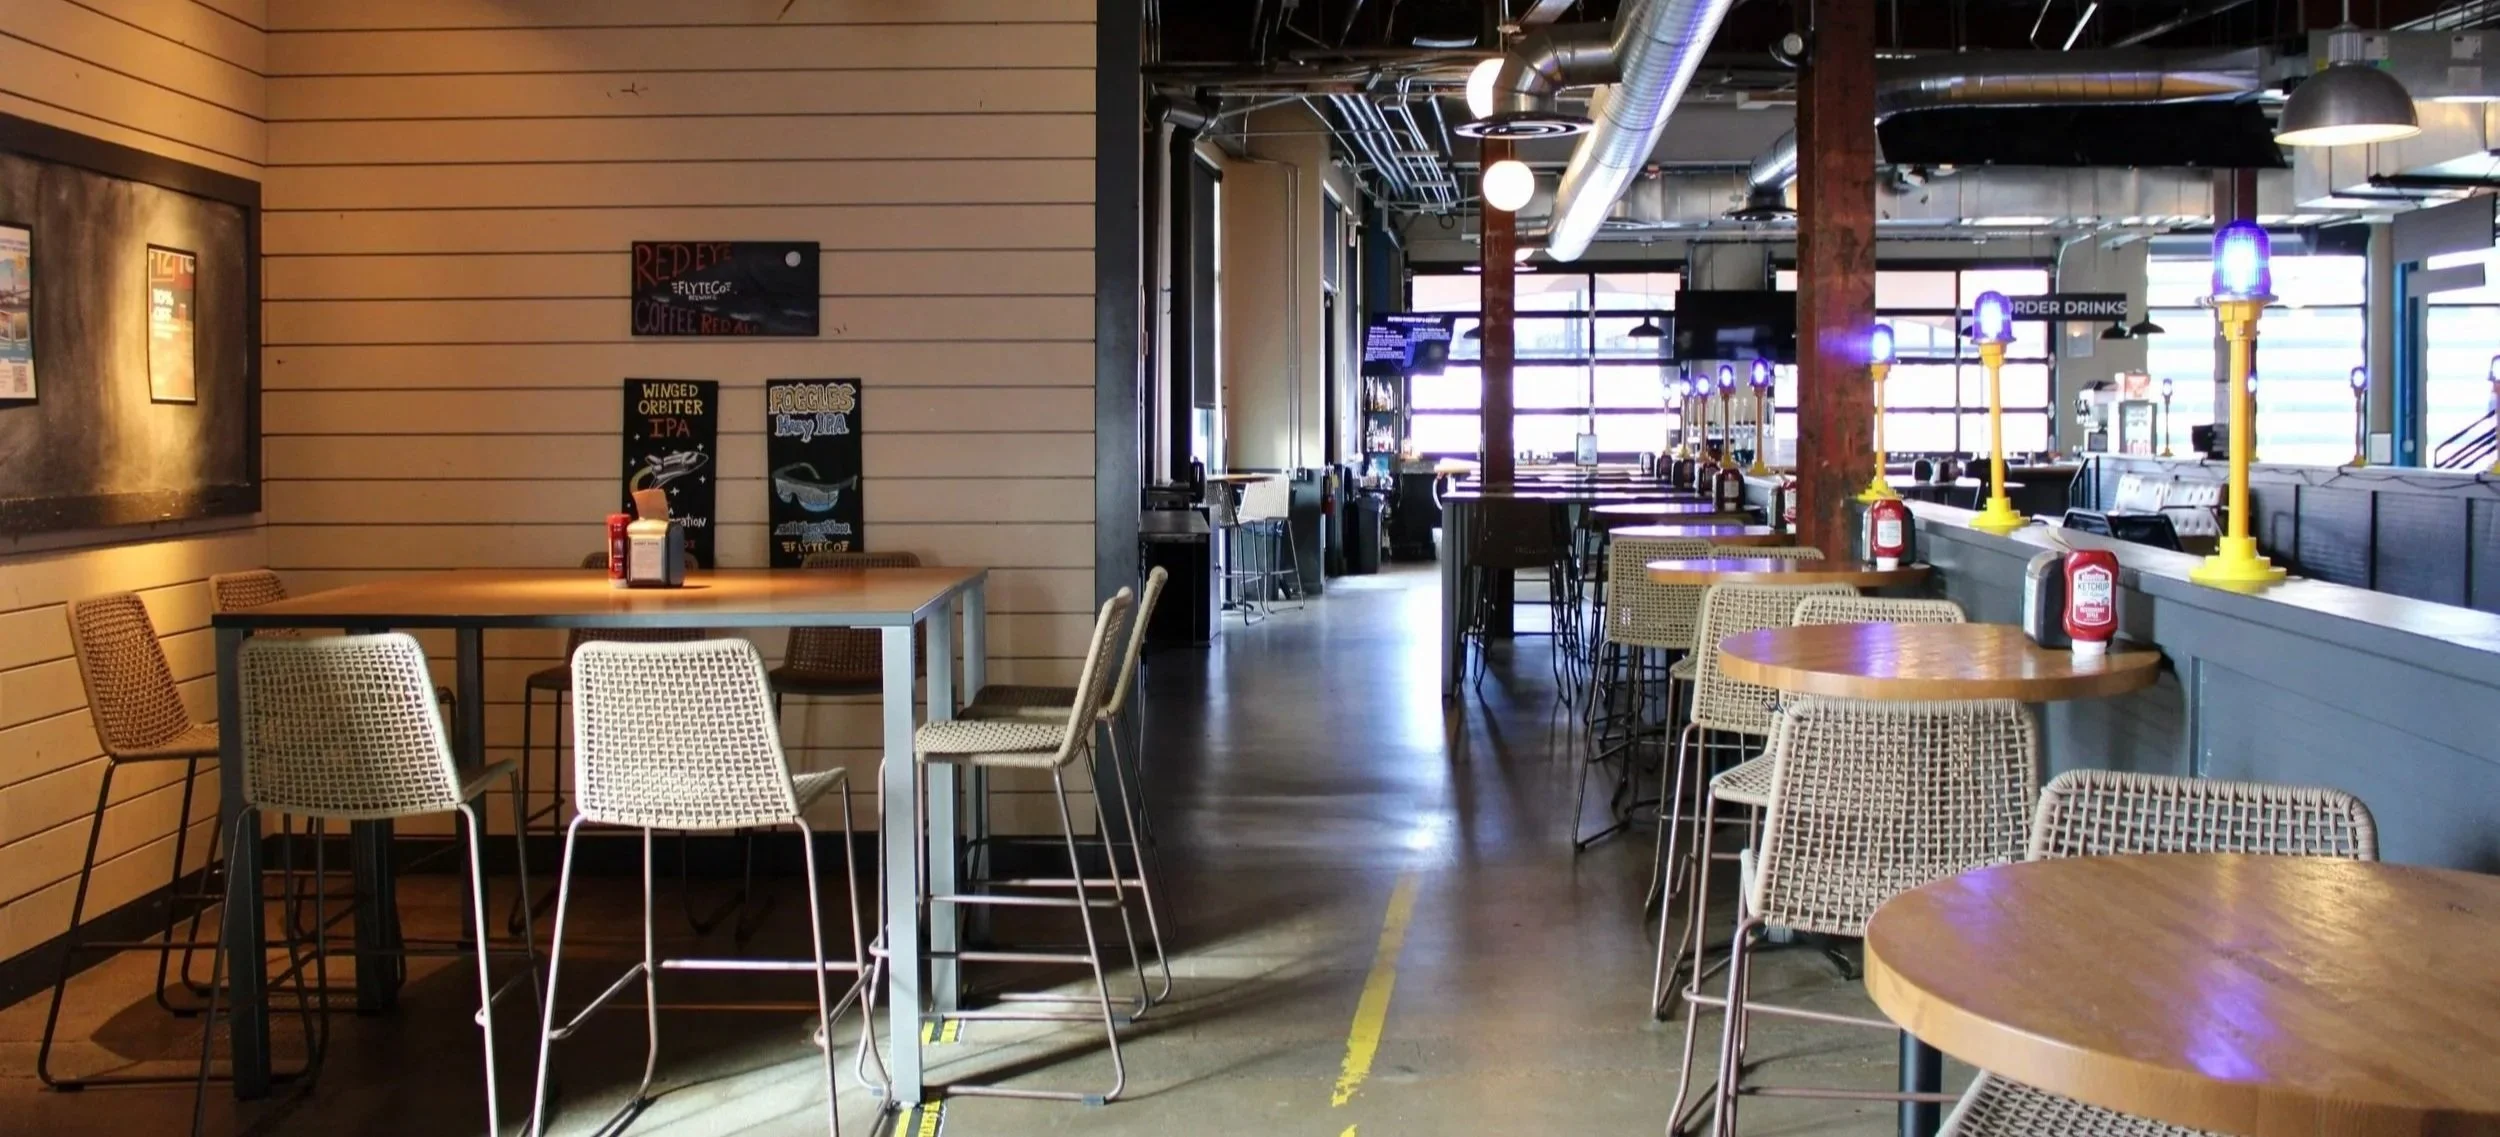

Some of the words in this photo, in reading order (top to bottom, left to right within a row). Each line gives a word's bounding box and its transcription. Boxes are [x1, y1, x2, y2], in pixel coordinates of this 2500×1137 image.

[634, 243, 692, 291] RED
[695, 242, 733, 272] EYE
[635, 298, 696, 334] COFFEE
[2010, 301, 2060, 314] RDER
[2064, 301, 2128, 314] DRINKS
[700, 312, 731, 335] RED
[642, 382, 698, 399] WINGED
[638, 399, 704, 415] ORBITER
[648, 418, 690, 438] IPA
[813, 412, 850, 437] IPA
[2078, 582, 2109, 592] KETCHUP
